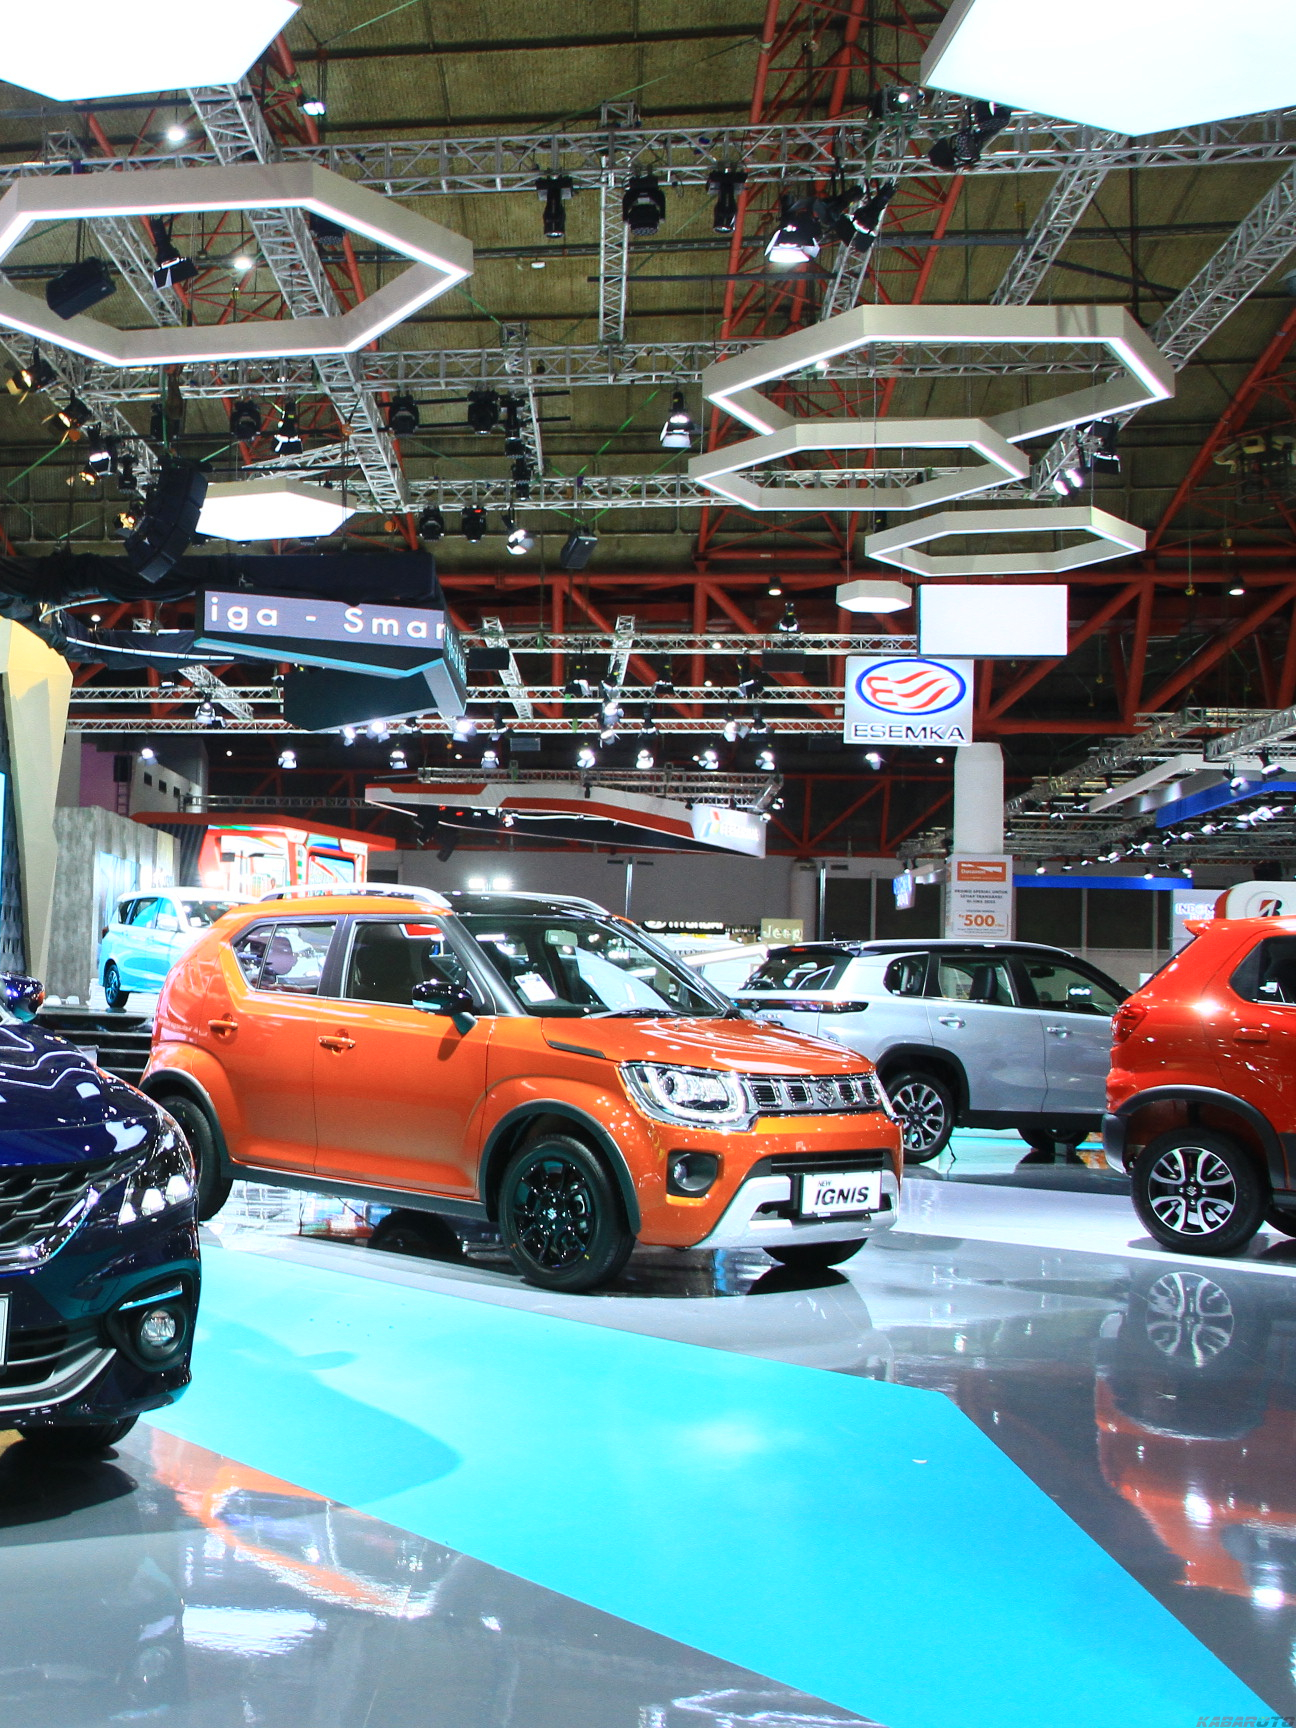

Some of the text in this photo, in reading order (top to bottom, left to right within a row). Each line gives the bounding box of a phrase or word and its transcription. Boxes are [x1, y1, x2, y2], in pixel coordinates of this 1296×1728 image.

[211, 596, 278, 631] iga
[344, 607, 446, 640] Smar
[853, 724, 966, 741] ESEMKA
[964, 914, 995, 927] 500
[814, 1187, 870, 1206] IGNIS
